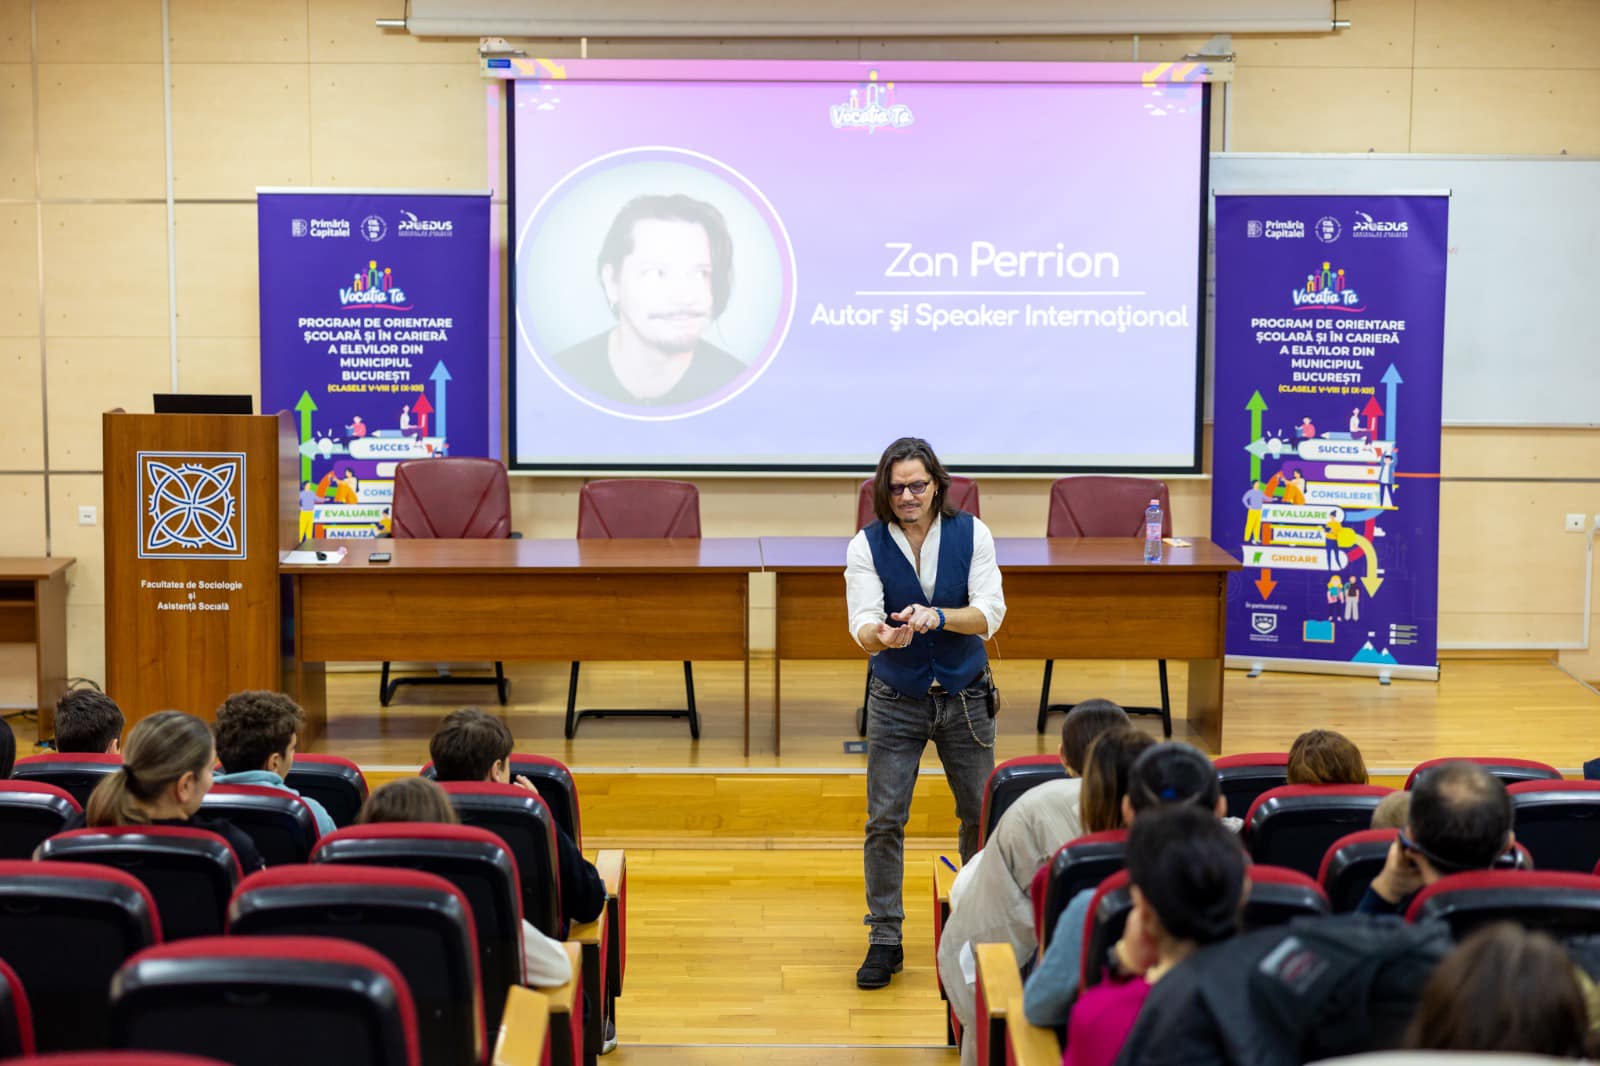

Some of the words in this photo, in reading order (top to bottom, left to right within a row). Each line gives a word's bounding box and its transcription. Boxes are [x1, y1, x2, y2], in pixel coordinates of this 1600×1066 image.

[884, 242, 959, 278] Zan
[970, 240, 1120, 279] Perrion
[388, 288, 406, 304] Ta
[1340, 289, 1359, 305] Ta
[298, 317, 361, 329] PROGRAM
[363, 317, 381, 329] DE
[383, 317, 453, 329] ORIENTARE
[810, 303, 883, 327] Autor
[914, 302, 1018, 332] Speaker
[1250, 317, 1313, 330] PROGRAM
[1315, 318, 1333, 330] DE
[1335, 319, 1406, 331] ORIENTARE
[377, 329, 391, 342] ÎN
[393, 329, 448, 342] CARIERĂ
[1329, 330, 1343, 343] ÎN
[1345, 332, 1400, 345] CARIERĂ
[327, 343, 338, 355] A
[339, 343, 399, 355] ELEVILOR
[400, 343, 424, 355] DIN
[1279, 344, 1290, 356] A
[1291, 345, 1350, 357] ELEVILOR
[1352, 346, 1376, 357] DIN
[339, 357, 413, 368] MUNICIPIUL
[1291, 358, 1364, 370] MUNICIPIUL
[369, 443, 411, 452] SUCCES
[1318, 445, 1359, 454] SUCCES
[1311, 490, 1374, 500] CONSILIERE
[324, 509, 380, 518] EVALUARE
[1271, 509, 1328, 520] EVALUARE
[1271, 554, 1318, 564] GHIDARE
[141, 579, 185, 589] Facultatea
[186, 580, 197, 589] de
[198, 580, 243, 591] Sociologie
